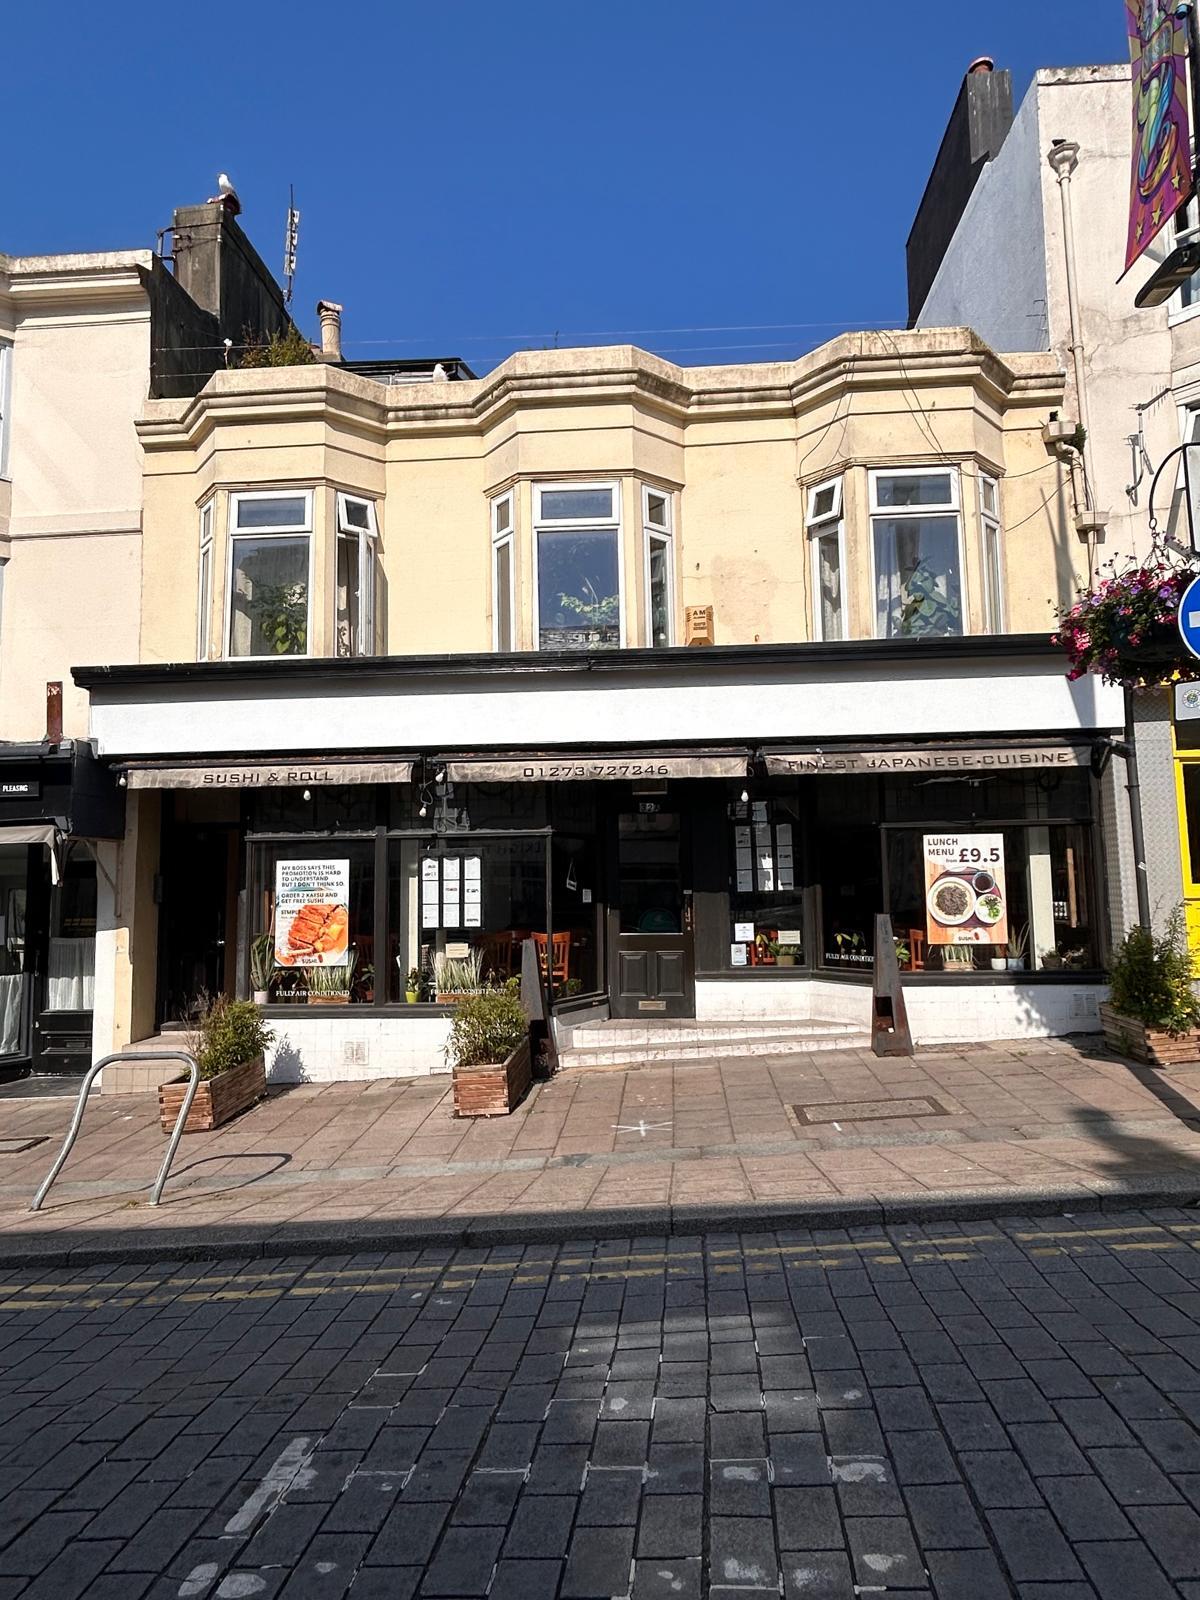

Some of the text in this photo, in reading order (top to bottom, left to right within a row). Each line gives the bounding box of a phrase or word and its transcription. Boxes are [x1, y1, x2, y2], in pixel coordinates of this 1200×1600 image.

[787, 752, 1069, 770] FINEST JAPANESE CUISINE
[203, 771, 333, 783] SUSHI & ROLL
[523, 765, 668, 777] 01273 727246
[927, 838, 958, 846] LUNCH
[928, 848, 955, 856] MENU
[959, 848, 1000, 862] £9.5
